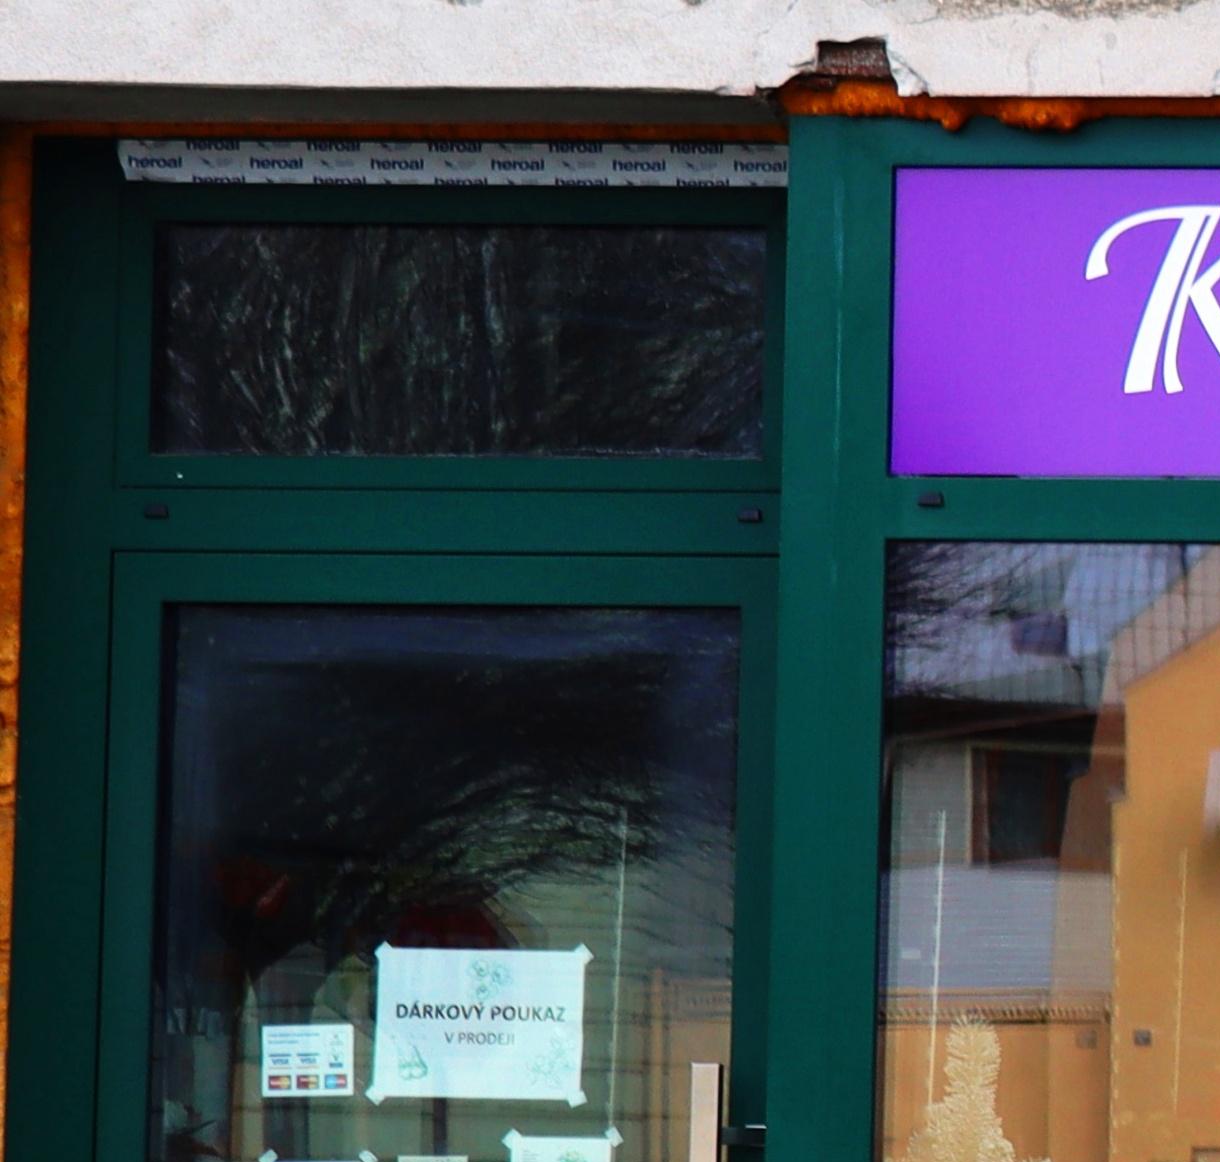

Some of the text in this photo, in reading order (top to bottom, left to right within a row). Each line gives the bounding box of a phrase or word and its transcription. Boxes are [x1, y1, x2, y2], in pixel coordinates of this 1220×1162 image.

[128, 155, 787, 173] heroal heroal heroal heroal heroal heroal
[396, 1001, 566, 1022] DÁRKOVÝ POUKAZ
[444, 1031, 516, 1046] V PRODEJI
